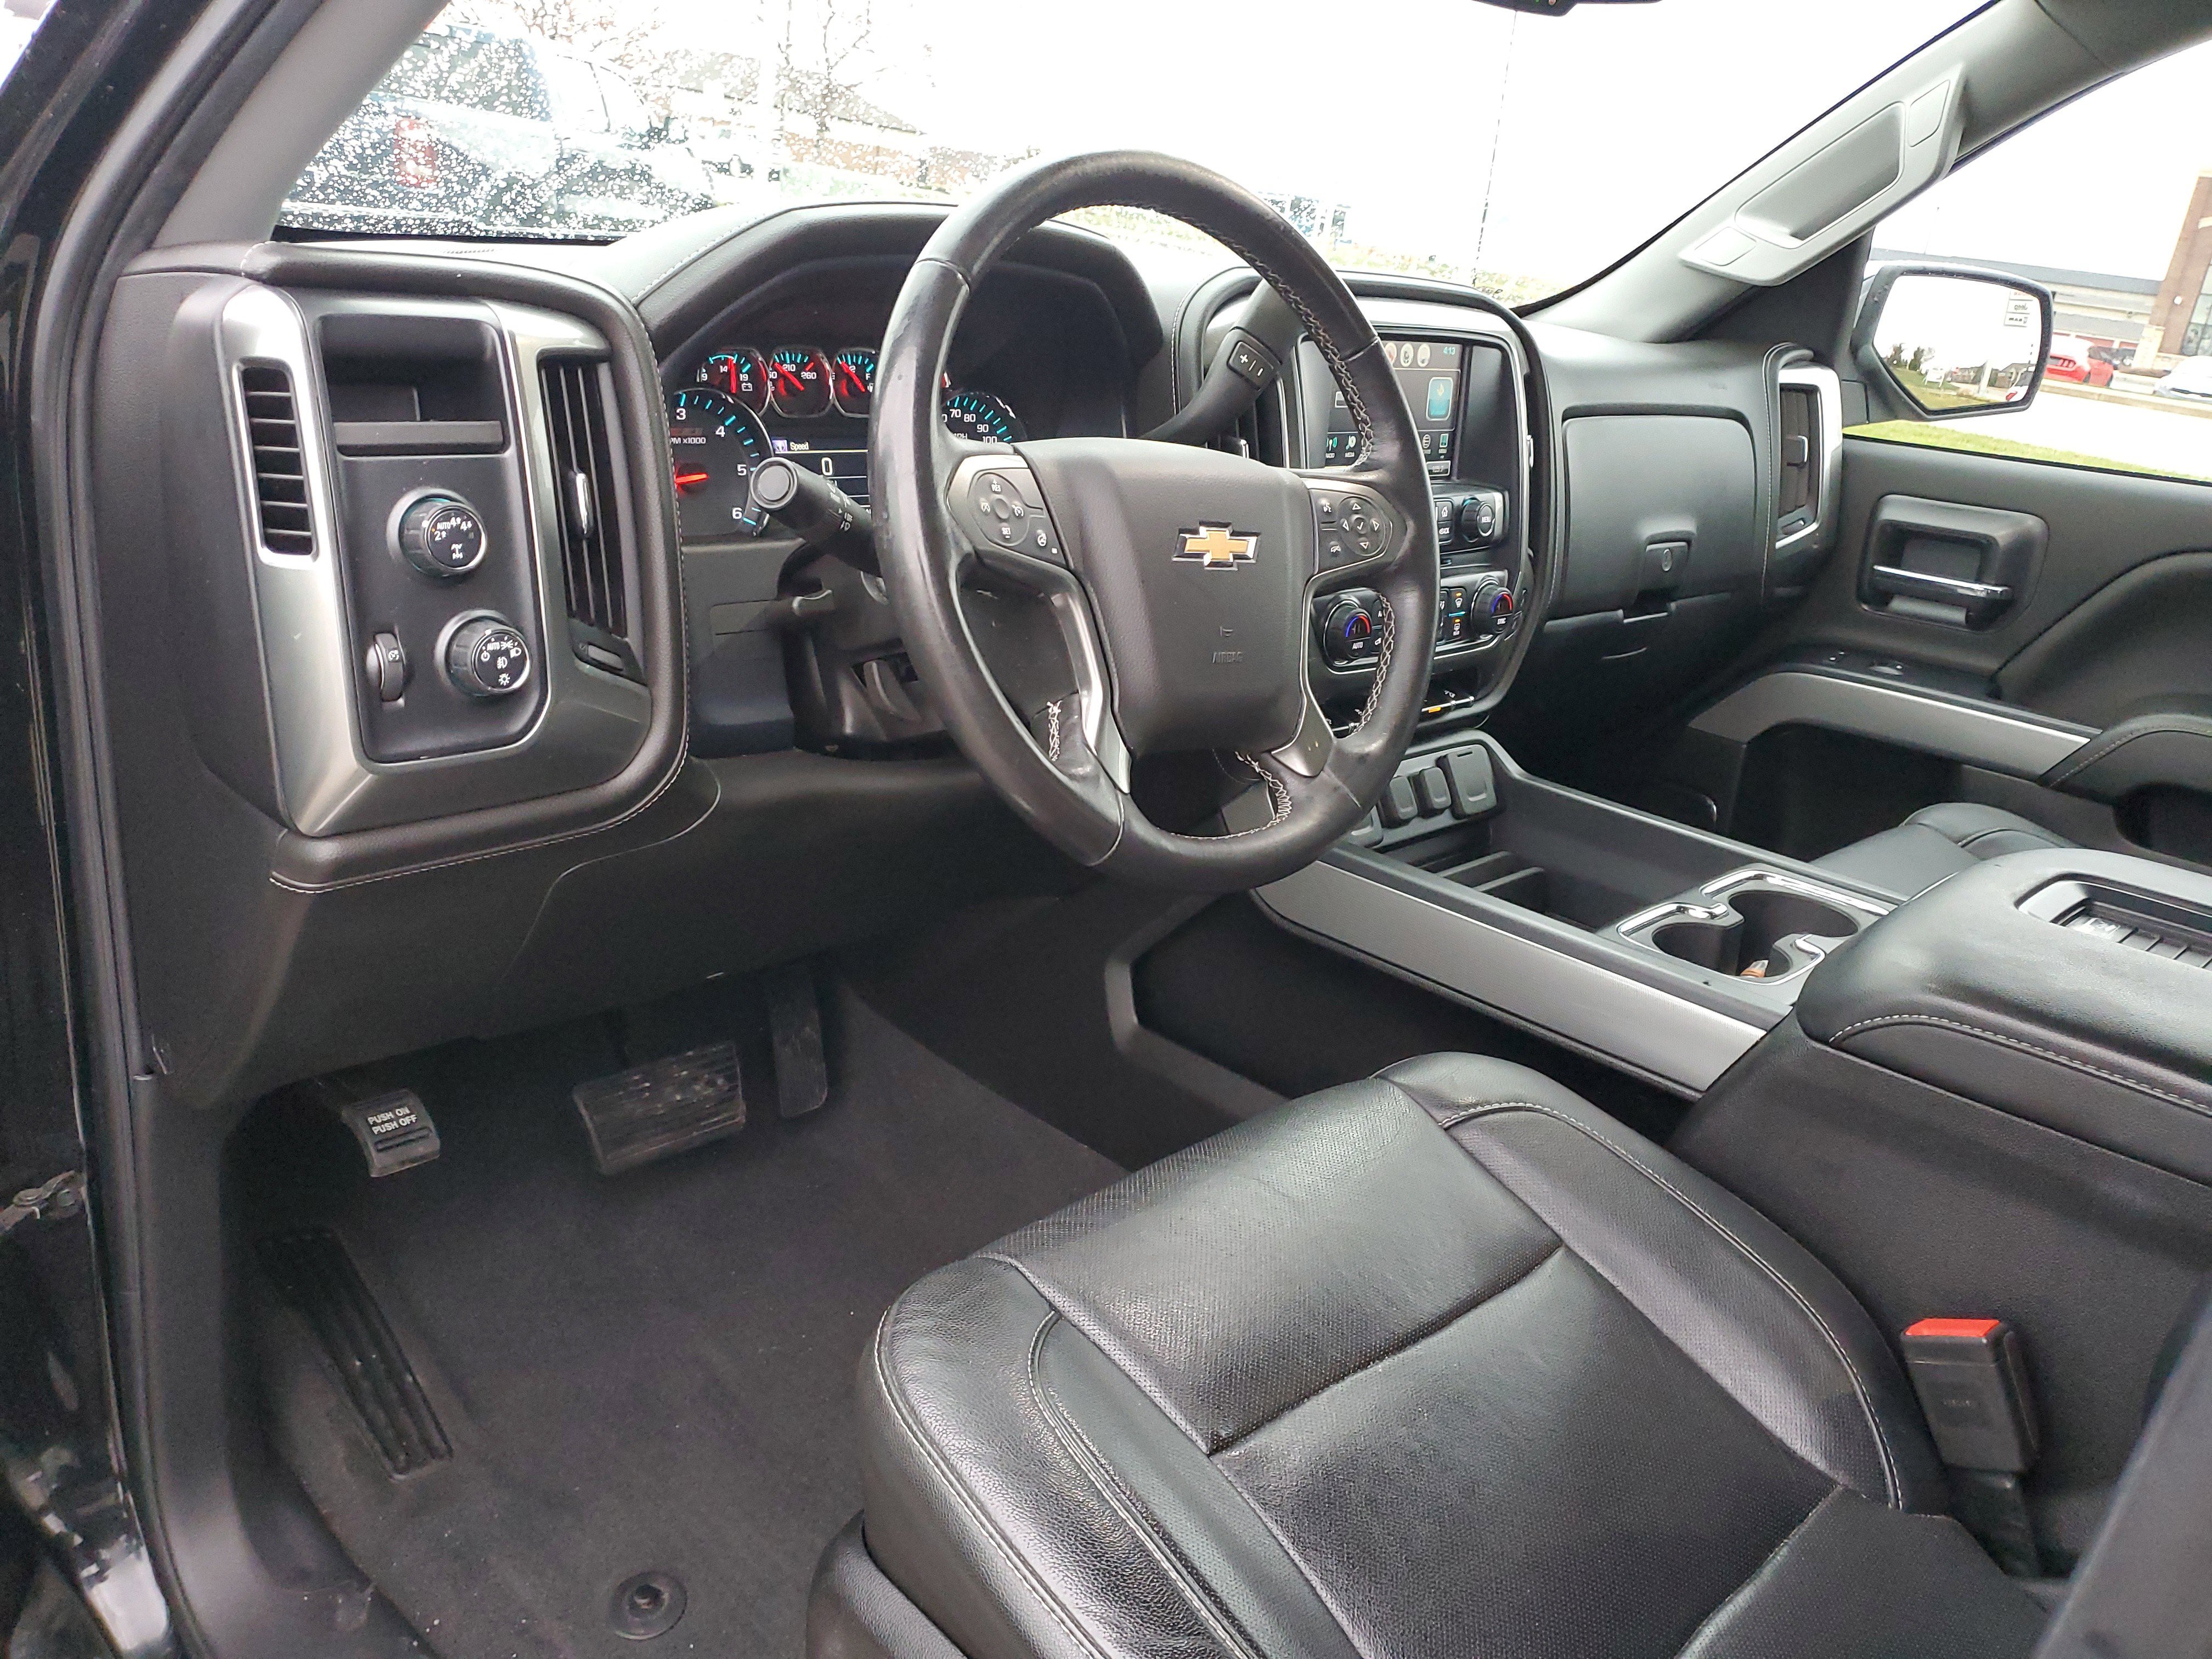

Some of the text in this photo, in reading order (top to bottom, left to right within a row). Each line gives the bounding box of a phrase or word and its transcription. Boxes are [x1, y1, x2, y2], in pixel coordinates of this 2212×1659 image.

[782, 364, 795, 372] 210
[701, 373, 708, 381] 9
[801, 371, 817, 380] 260
[676, 408, 686, 420] 3
[941, 414, 947, 422] 0
[949, 409, 961, 418] 70
[963, 414, 976, 422] 80
[715, 426, 726, 437] 4
[977, 424, 989, 433] 90
[789, 442, 809, 451] Speed
[737, 464, 747, 476] 5
[821, 457, 833, 476] 0
[732, 507, 742, 520] 6
[437, 521, 451, 530] AUTO
[487, 642, 500, 651] AUTO
[1352, 641, 1363, 650] AUTO
[367, 1107, 411, 1125] PUSH ON
[371, 1114, 417, 1135] PUSH OFF
